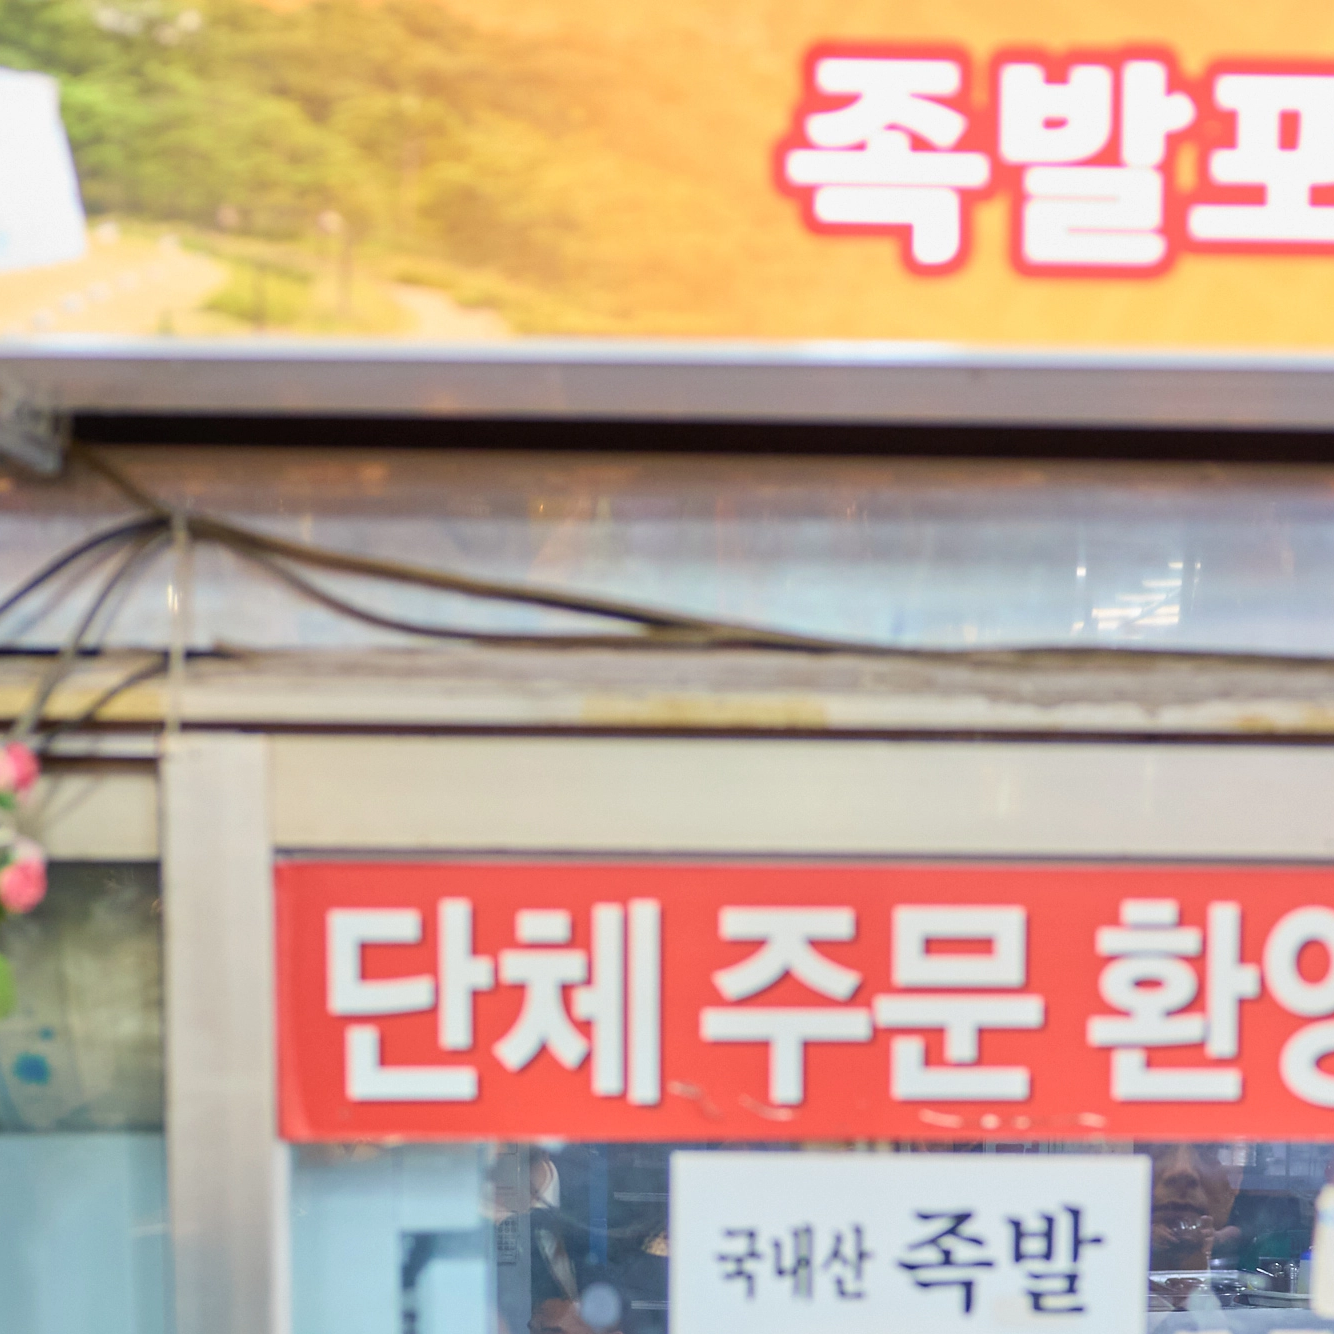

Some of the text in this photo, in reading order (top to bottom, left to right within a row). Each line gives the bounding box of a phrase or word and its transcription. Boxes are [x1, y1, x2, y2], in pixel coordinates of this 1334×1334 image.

[325, 896, 662, 1106] 단체
[699, 904, 1046, 1106] 주문
[717, 1203, 1105, 1316] 국내산 족발
